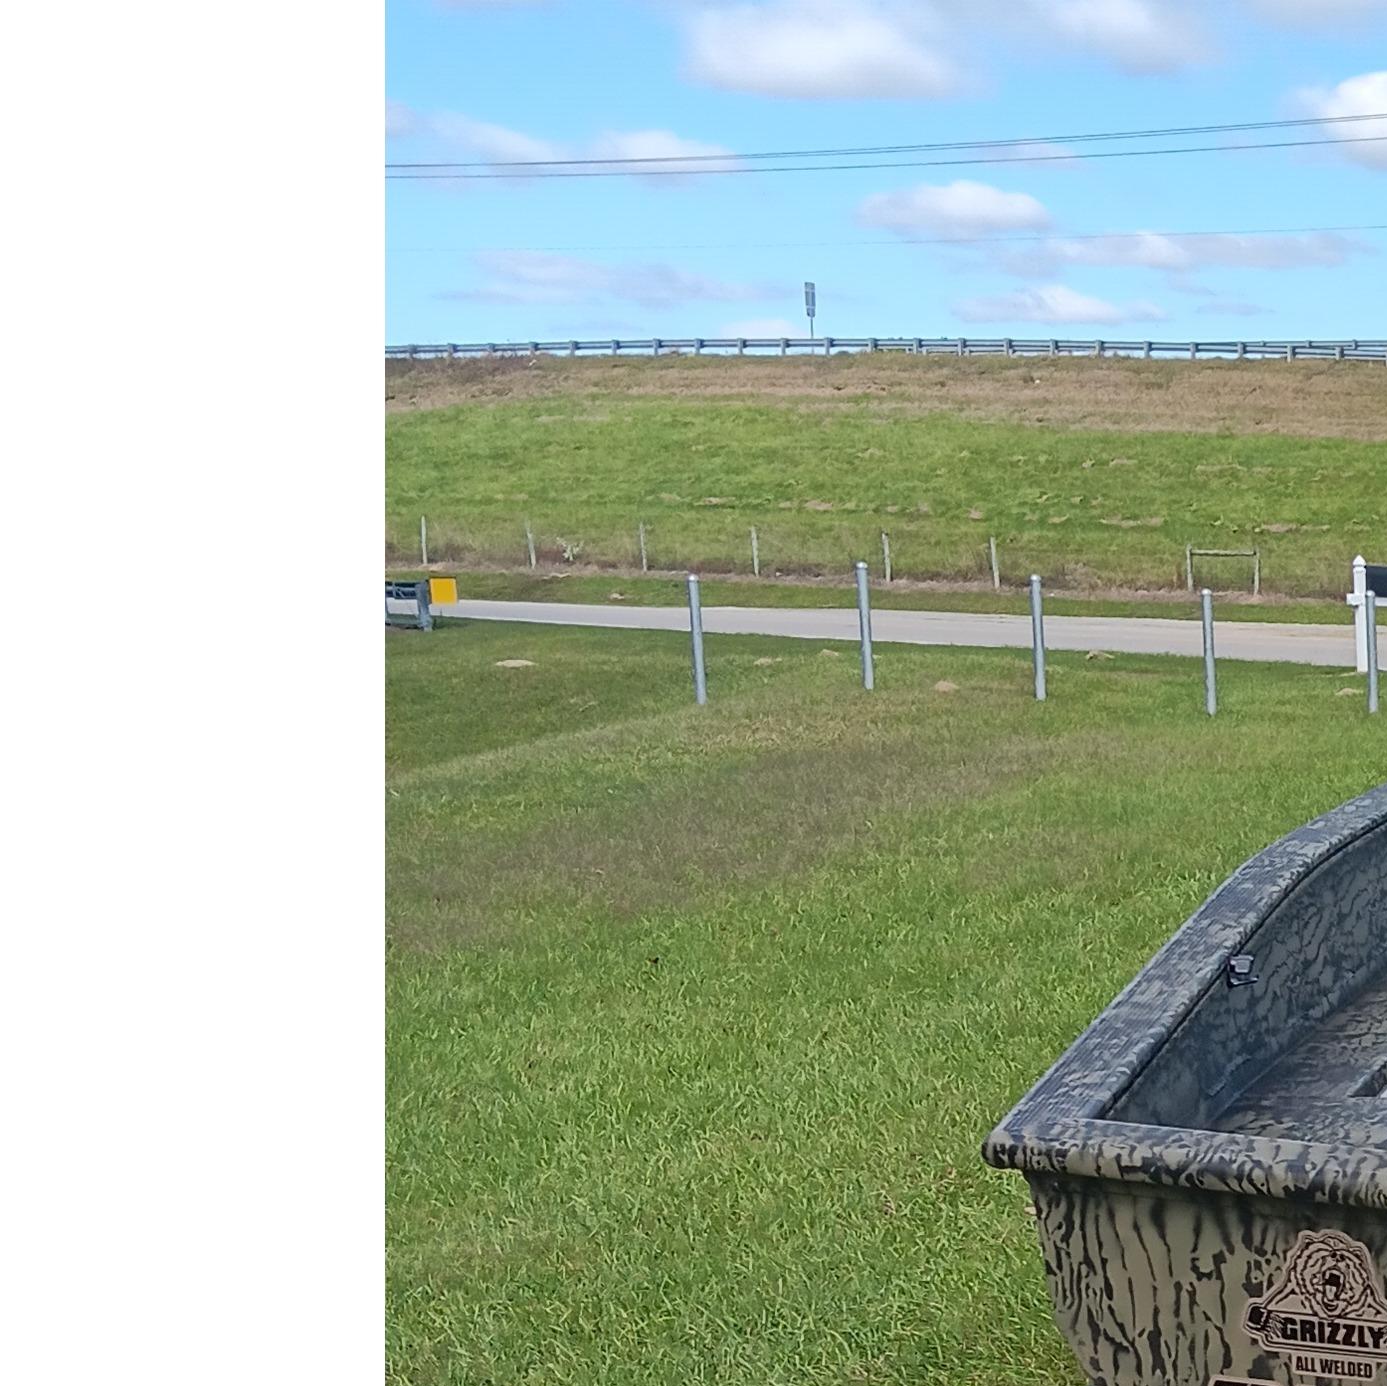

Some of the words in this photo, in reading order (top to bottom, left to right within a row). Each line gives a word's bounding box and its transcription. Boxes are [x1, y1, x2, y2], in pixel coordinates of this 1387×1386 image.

[1282, 1317, 1385, 1349] GRIZZLY
[1295, 1356, 1317, 1373] ALL
[1320, 1359, 1373, 1378] WELDED
